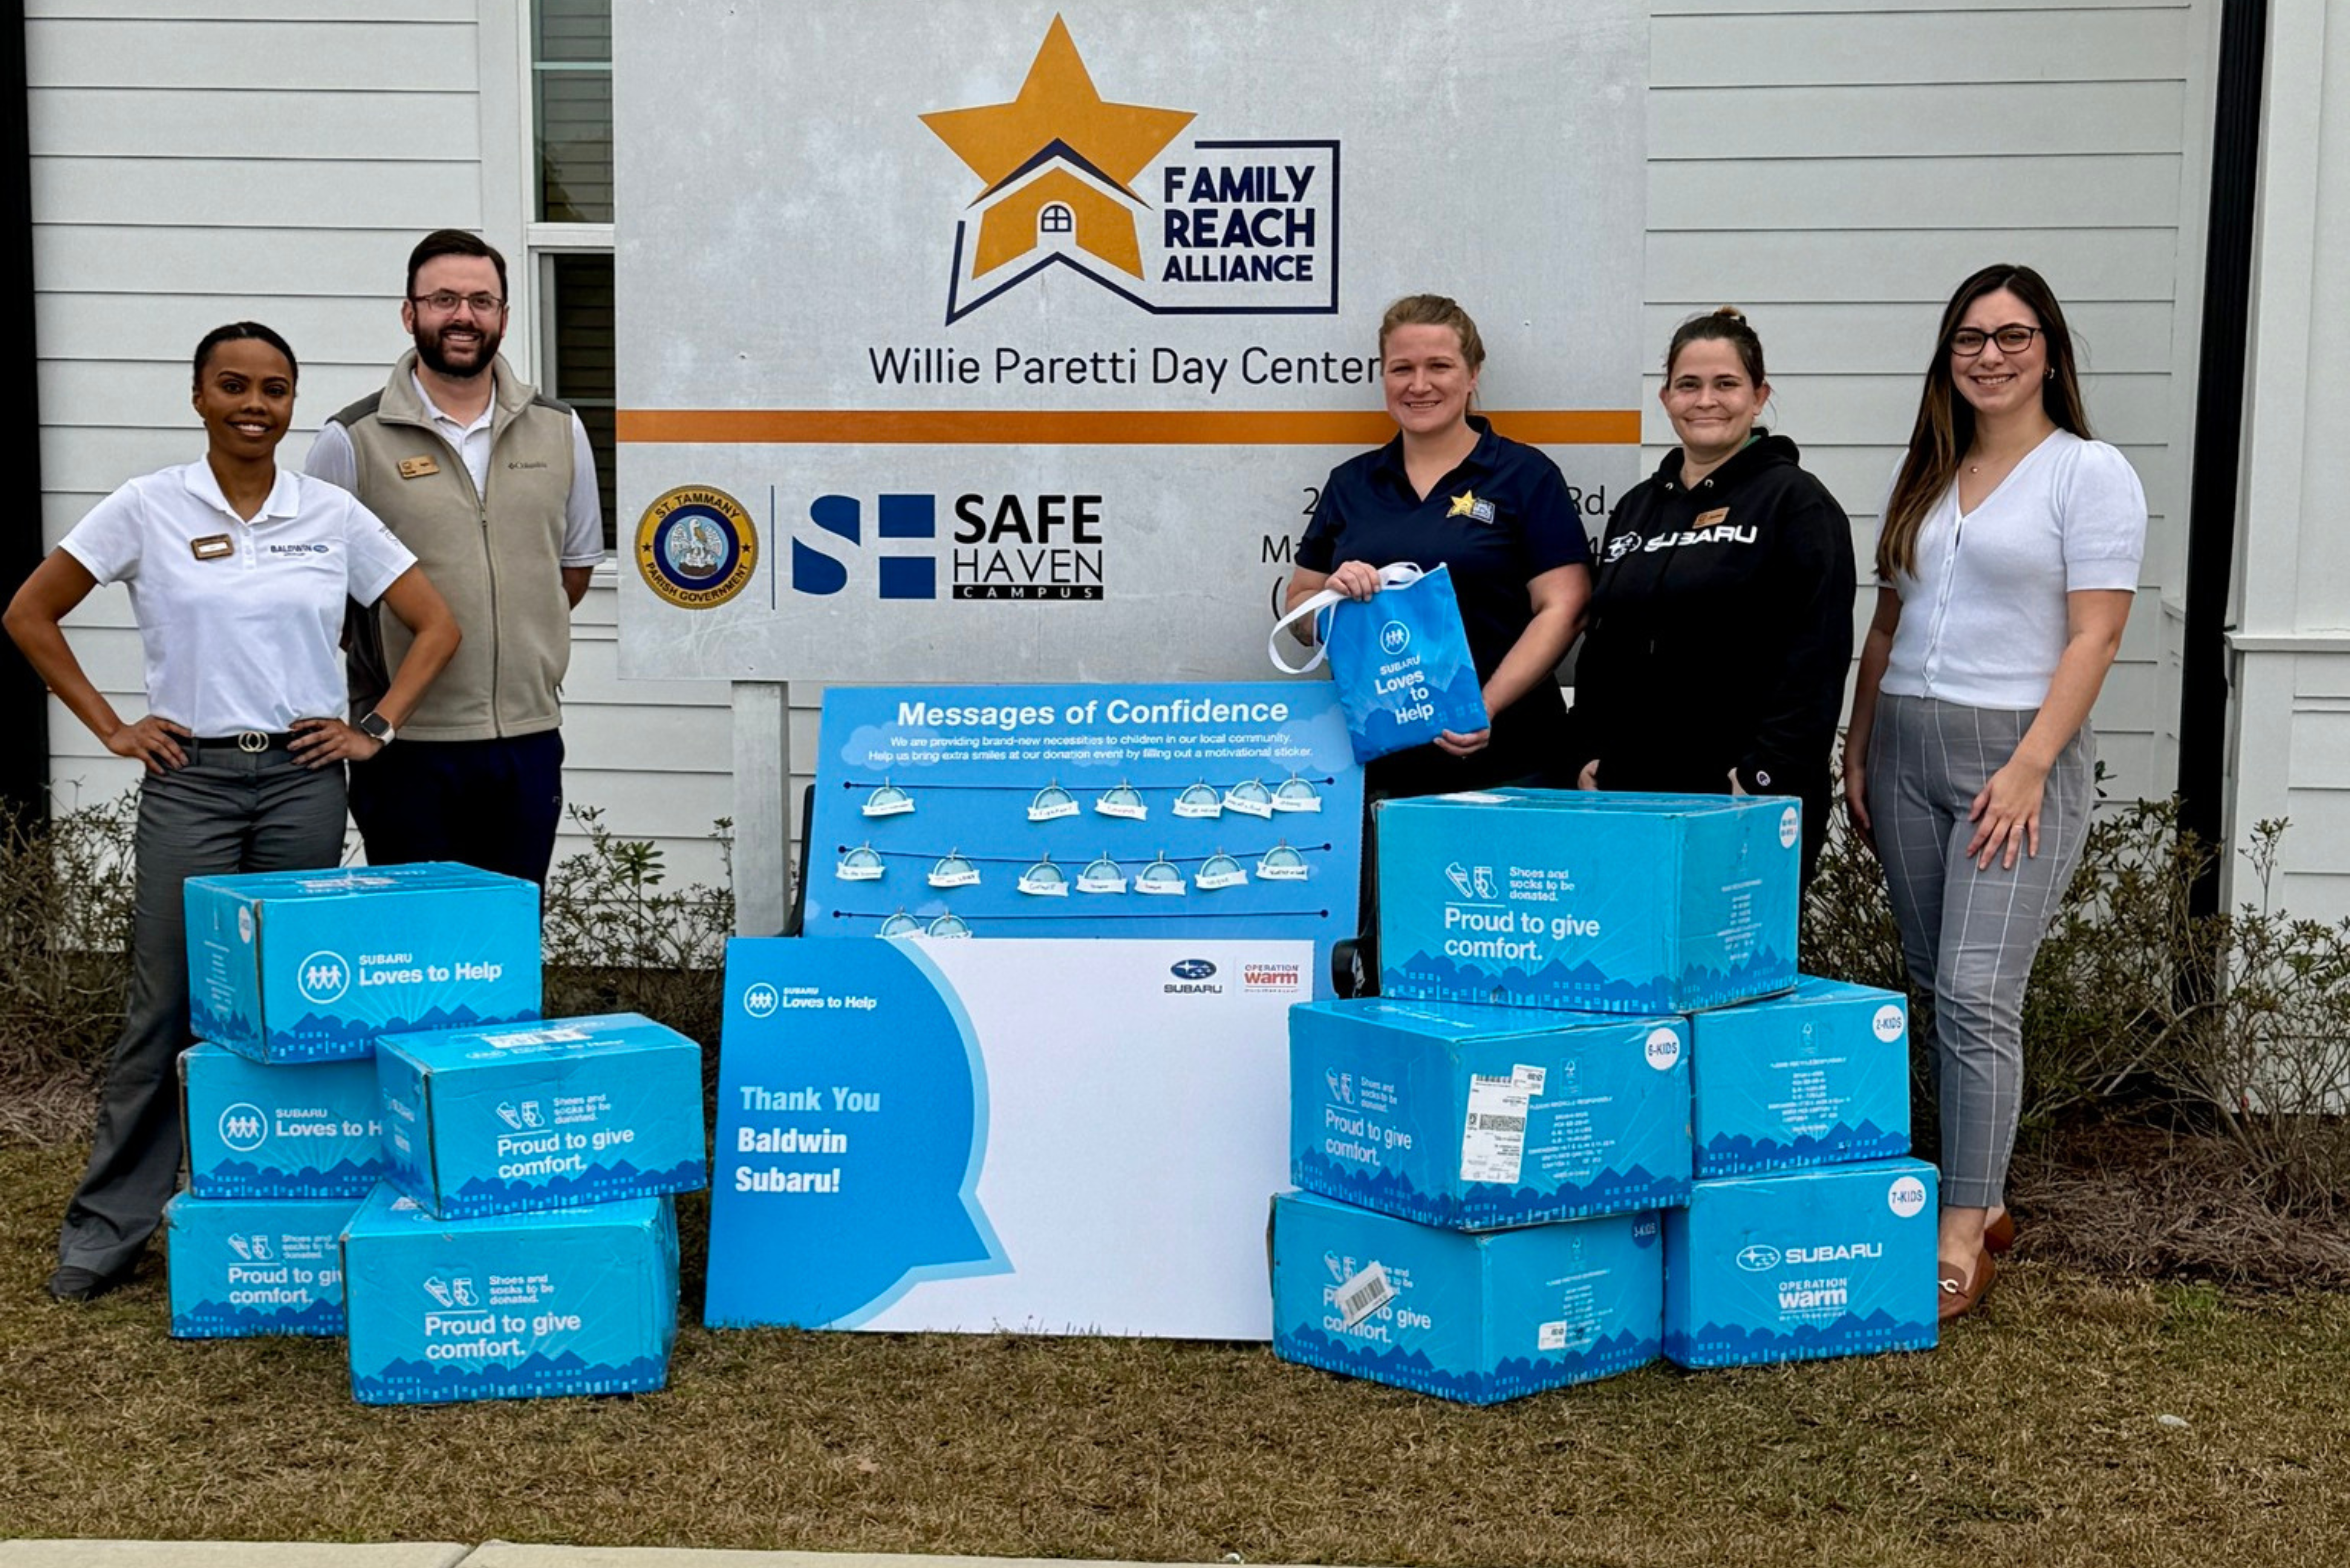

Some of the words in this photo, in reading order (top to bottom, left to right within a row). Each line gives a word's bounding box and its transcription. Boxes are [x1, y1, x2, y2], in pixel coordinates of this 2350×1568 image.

[1164, 165, 1316, 203] FAMILY
[1164, 208, 1316, 248] REACH
[1161, 254, 1314, 282] ALLIANCE
[868, 346, 981, 385] Willie
[995, 346, 1138, 385] Paretti
[1151, 347, 1228, 395] Day
[1241, 346, 1382, 385] Center
[654, 501, 675, 519] ST.
[675, 492, 741, 520] TAMMANY
[953, 493, 1103, 545] SAFE
[270, 544, 312, 553] BALDWIN
[1644, 525, 1758, 552] SUBARU
[953, 549, 1103, 583] HAVEN
[646, 562, 678, 597] PARISH
[678, 564, 749, 603] GOVERNMENT
[963, 586, 1094, 599] CAMPUS
[1379, 654, 1421, 676] SUBARU
[1374, 669, 1425, 696] Loves
[1409, 685, 1430, 702] to
[897, 701, 1056, 732] Messages
[1065, 700, 1099, 725] of
[1106, 698, 1290, 725] Confidence
[1394, 702, 1435, 726] Help
[890, 736, 908, 748] We
[910, 738, 928, 748] are
[929, 735, 980, 750] providing
[982, 734, 1041, 747] brand-new
[1043, 734, 1104, 746] necessities
[1106, 735, 1118, 745] to
[1120, 733, 1164, 745] children
[1166, 733, 1176, 744] in
[1179, 735, 1197, 744] our
[1200, 733, 1227, 744] local
[1228, 732, 1292, 746] community.
[868, 750, 893, 764] Help
[896, 752, 910, 763] us
[911, 750, 939, 765] bring
[942, 751, 969, 762] extra
[972, 749, 1006, 762] smiles
[1009, 751, 1020, 761] at
[1022, 751, 1041, 761] our
[1043, 749, 1091, 761] donation
[1093, 750, 1124, 760] event
[1126, 748, 1140, 761] by
[1143, 747, 1171, 762] filling
[1174, 748, 1193, 760] out
[1195, 750, 1203, 759] a
[1205, 746, 1272, 759] motivational
[1274, 746, 1314, 758] sticker.
[1509, 866, 1545, 879] Shoes
[1548, 869, 1569, 881] and
[1509, 878, 1543, 890] socks
[1546, 880, 1558, 890] to
[1560, 880, 1575, 891] be
[1509, 889, 1559, 902] donated.
[1444, 907, 1514, 933] Proud
[1520, 911, 1545, 934] to
[1551, 914, 1601, 940] give
[1444, 936, 1544, 961] comfort.
[359, 952, 413, 966] SUBARU
[1245, 964, 1299, 972] OPERATION
[359, 967, 423, 987] Loves
[427, 964, 450, 983] to
[455, 961, 502, 983] Help
[1244, 971, 1298, 984] warm
[783, 986, 819, 995] SUBARU
[1164, 984, 1223, 994] SUBARU
[783, 995, 824, 1009] Loves
[827, 995, 842, 1009] to
[845, 995, 877, 1011] Help
[1876, 1016, 1903, 1031] 2-KIDS
[554, 1096, 585, 1107] Shoes
[587, 1093, 606, 1103] and
[554, 1104, 584, 1116] socks
[586, 1103, 597, 1113] to
[598, 1101, 612, 1111] be
[740, 1086, 822, 1112] Thank
[831, 1086, 881, 1112] You
[275, 1108, 328, 1119] SUBARU
[275, 1120, 338, 1137] Loves
[342, 1121, 363, 1137] to
[1325, 1108, 1364, 1137] Proud
[1368, 1119, 1381, 1142] to
[1384, 1125, 1412, 1150] give
[497, 1132, 560, 1157] Proud
[565, 1131, 587, 1149] to
[591, 1128, 635, 1151] give
[737, 1126, 848, 1154] Baldwin
[1325, 1137, 1381, 1168] comfort.
[498, 1153, 588, 1179] comfort.
[735, 1166, 841, 1193] Subaru!
[1891, 1189, 1924, 1204] 7-KIDS
[281, 1233, 312, 1243] Shoes
[314, 1234, 333, 1243] and
[282, 1243, 309, 1252] socks
[1785, 1242, 1883, 1264] SUBARU
[228, 1266, 288, 1285] Proud
[292, 1267, 314, 1284] to
[489, 1274, 524, 1286] Shoes
[527, 1273, 549, 1284] and
[1778, 1276, 1848, 1292] OPERATION
[228, 1287, 315, 1305] comfort.
[489, 1284, 523, 1295] socks
[526, 1283, 538, 1294] to
[540, 1281, 555, 1293] be
[489, 1294, 539, 1306] donated.
[1778, 1287, 1848, 1310] warm
[425, 1313, 497, 1336] Proud
[502, 1315, 527, 1333] to
[531, 1312, 581, 1336] give
[1396, 1307, 1432, 1329] give
[425, 1338, 527, 1360] comfort.
